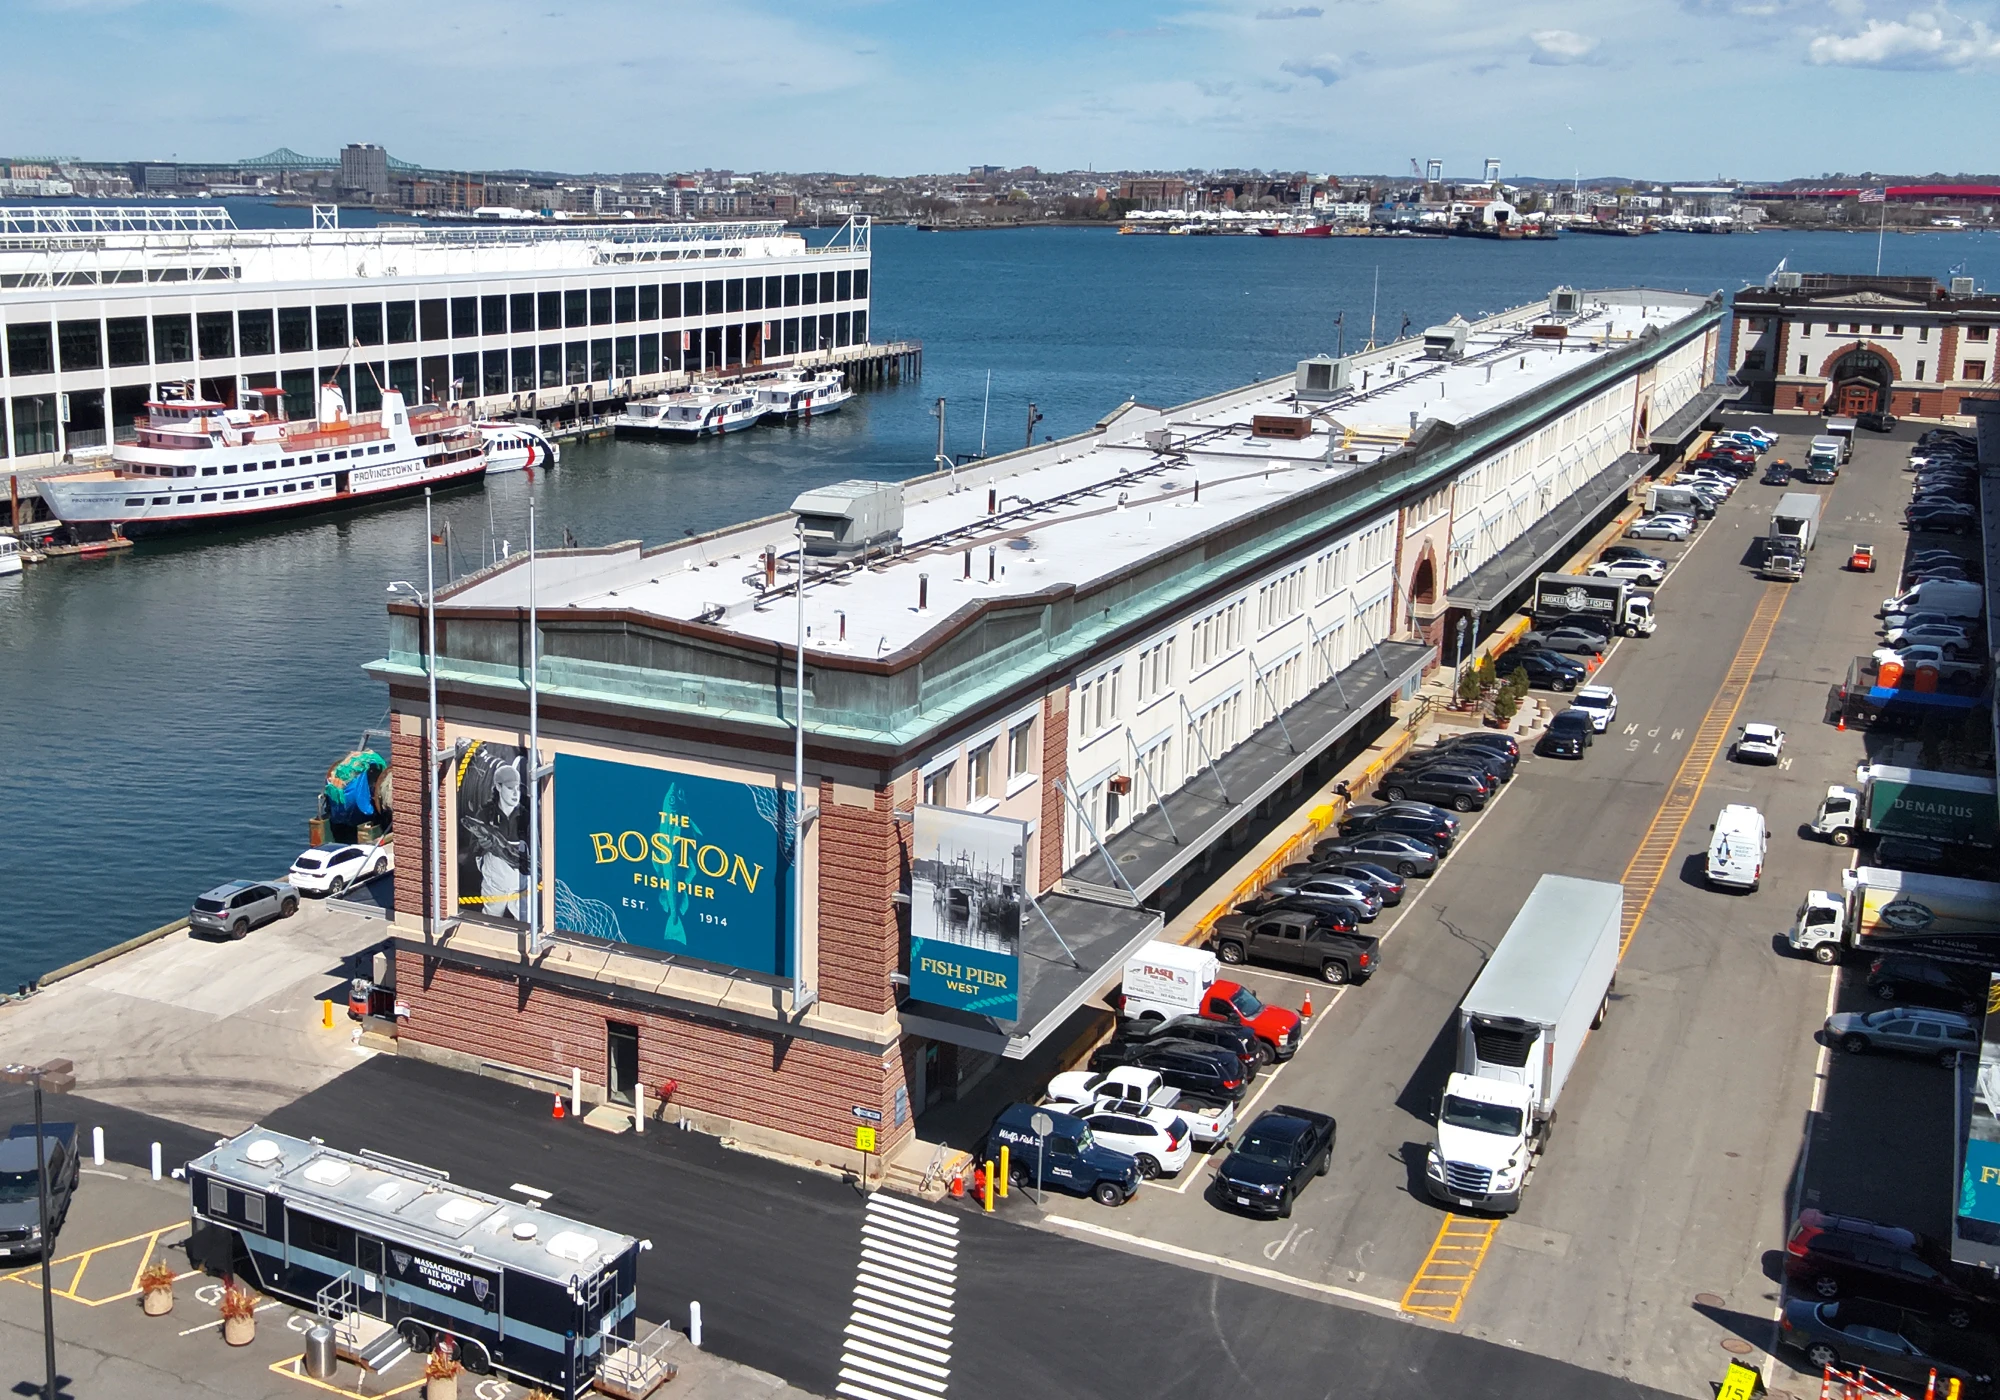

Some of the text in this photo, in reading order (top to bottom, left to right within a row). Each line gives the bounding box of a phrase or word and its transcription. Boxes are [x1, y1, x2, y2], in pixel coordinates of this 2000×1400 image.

[353, 463, 413, 482] PROVINCETOWN
[1541, 595, 1565, 604] SMOKED
[1590, 600, 1604, 608] FISH
[1894, 798, 1974, 818] DENARIUS
[658, 811, 690, 828] THE
[589, 830, 764, 894] BOSTON
[633, 873, 715, 899] FISH PIER
[699, 912, 728, 927] 1914
[920, 956, 1008, 989] FISH PIER
[1143, 965, 1174, 982] FRASER
[946, 980, 980, 995] WEST
[860, 1138, 871, 1148] 15
[1019, 1134, 1034, 1145] Fish
[413, 1256, 471, 1282] MASSACHUSETTS
[419, 1265, 466, 1288] STATE POLICE
[427, 1277, 452, 1291] TROOP
[1731, 1367, 1753, 1380] SPEED
[1725, 1384, 1745, 1400] 15
